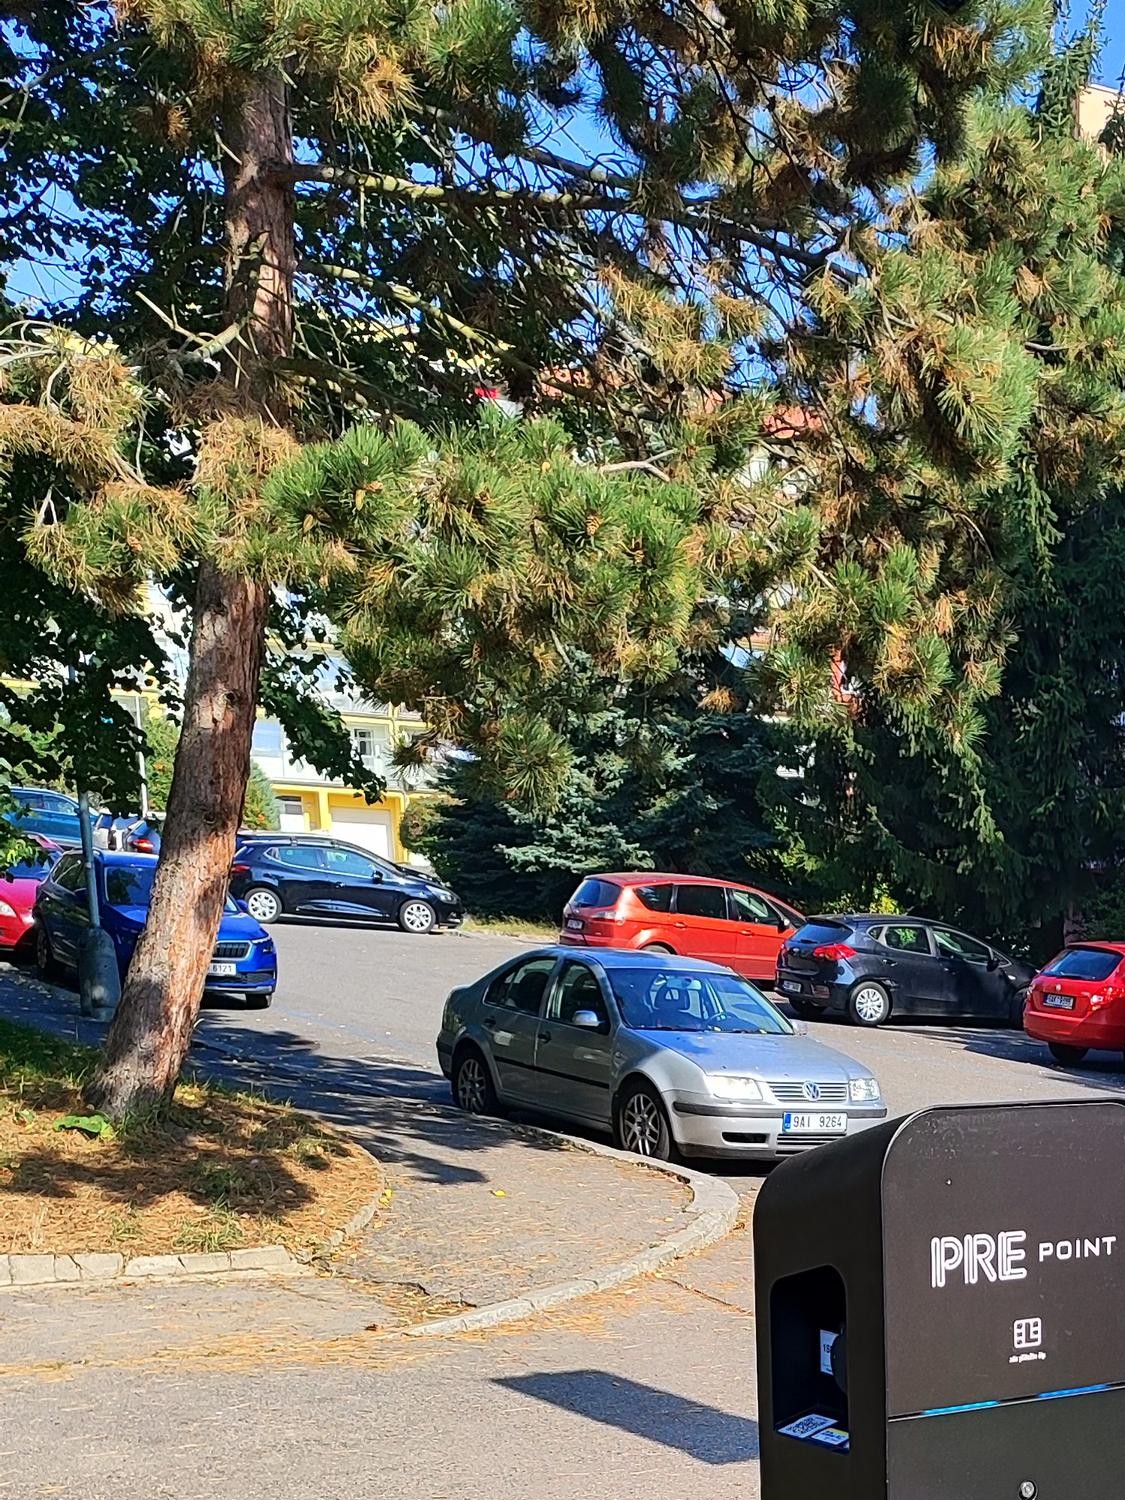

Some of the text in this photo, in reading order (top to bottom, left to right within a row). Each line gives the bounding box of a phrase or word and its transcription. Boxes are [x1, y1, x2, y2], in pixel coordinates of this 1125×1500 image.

[793, 1116, 842, 1128] 9AI 9264
[930, 1230, 1117, 1288] PRE POINT
